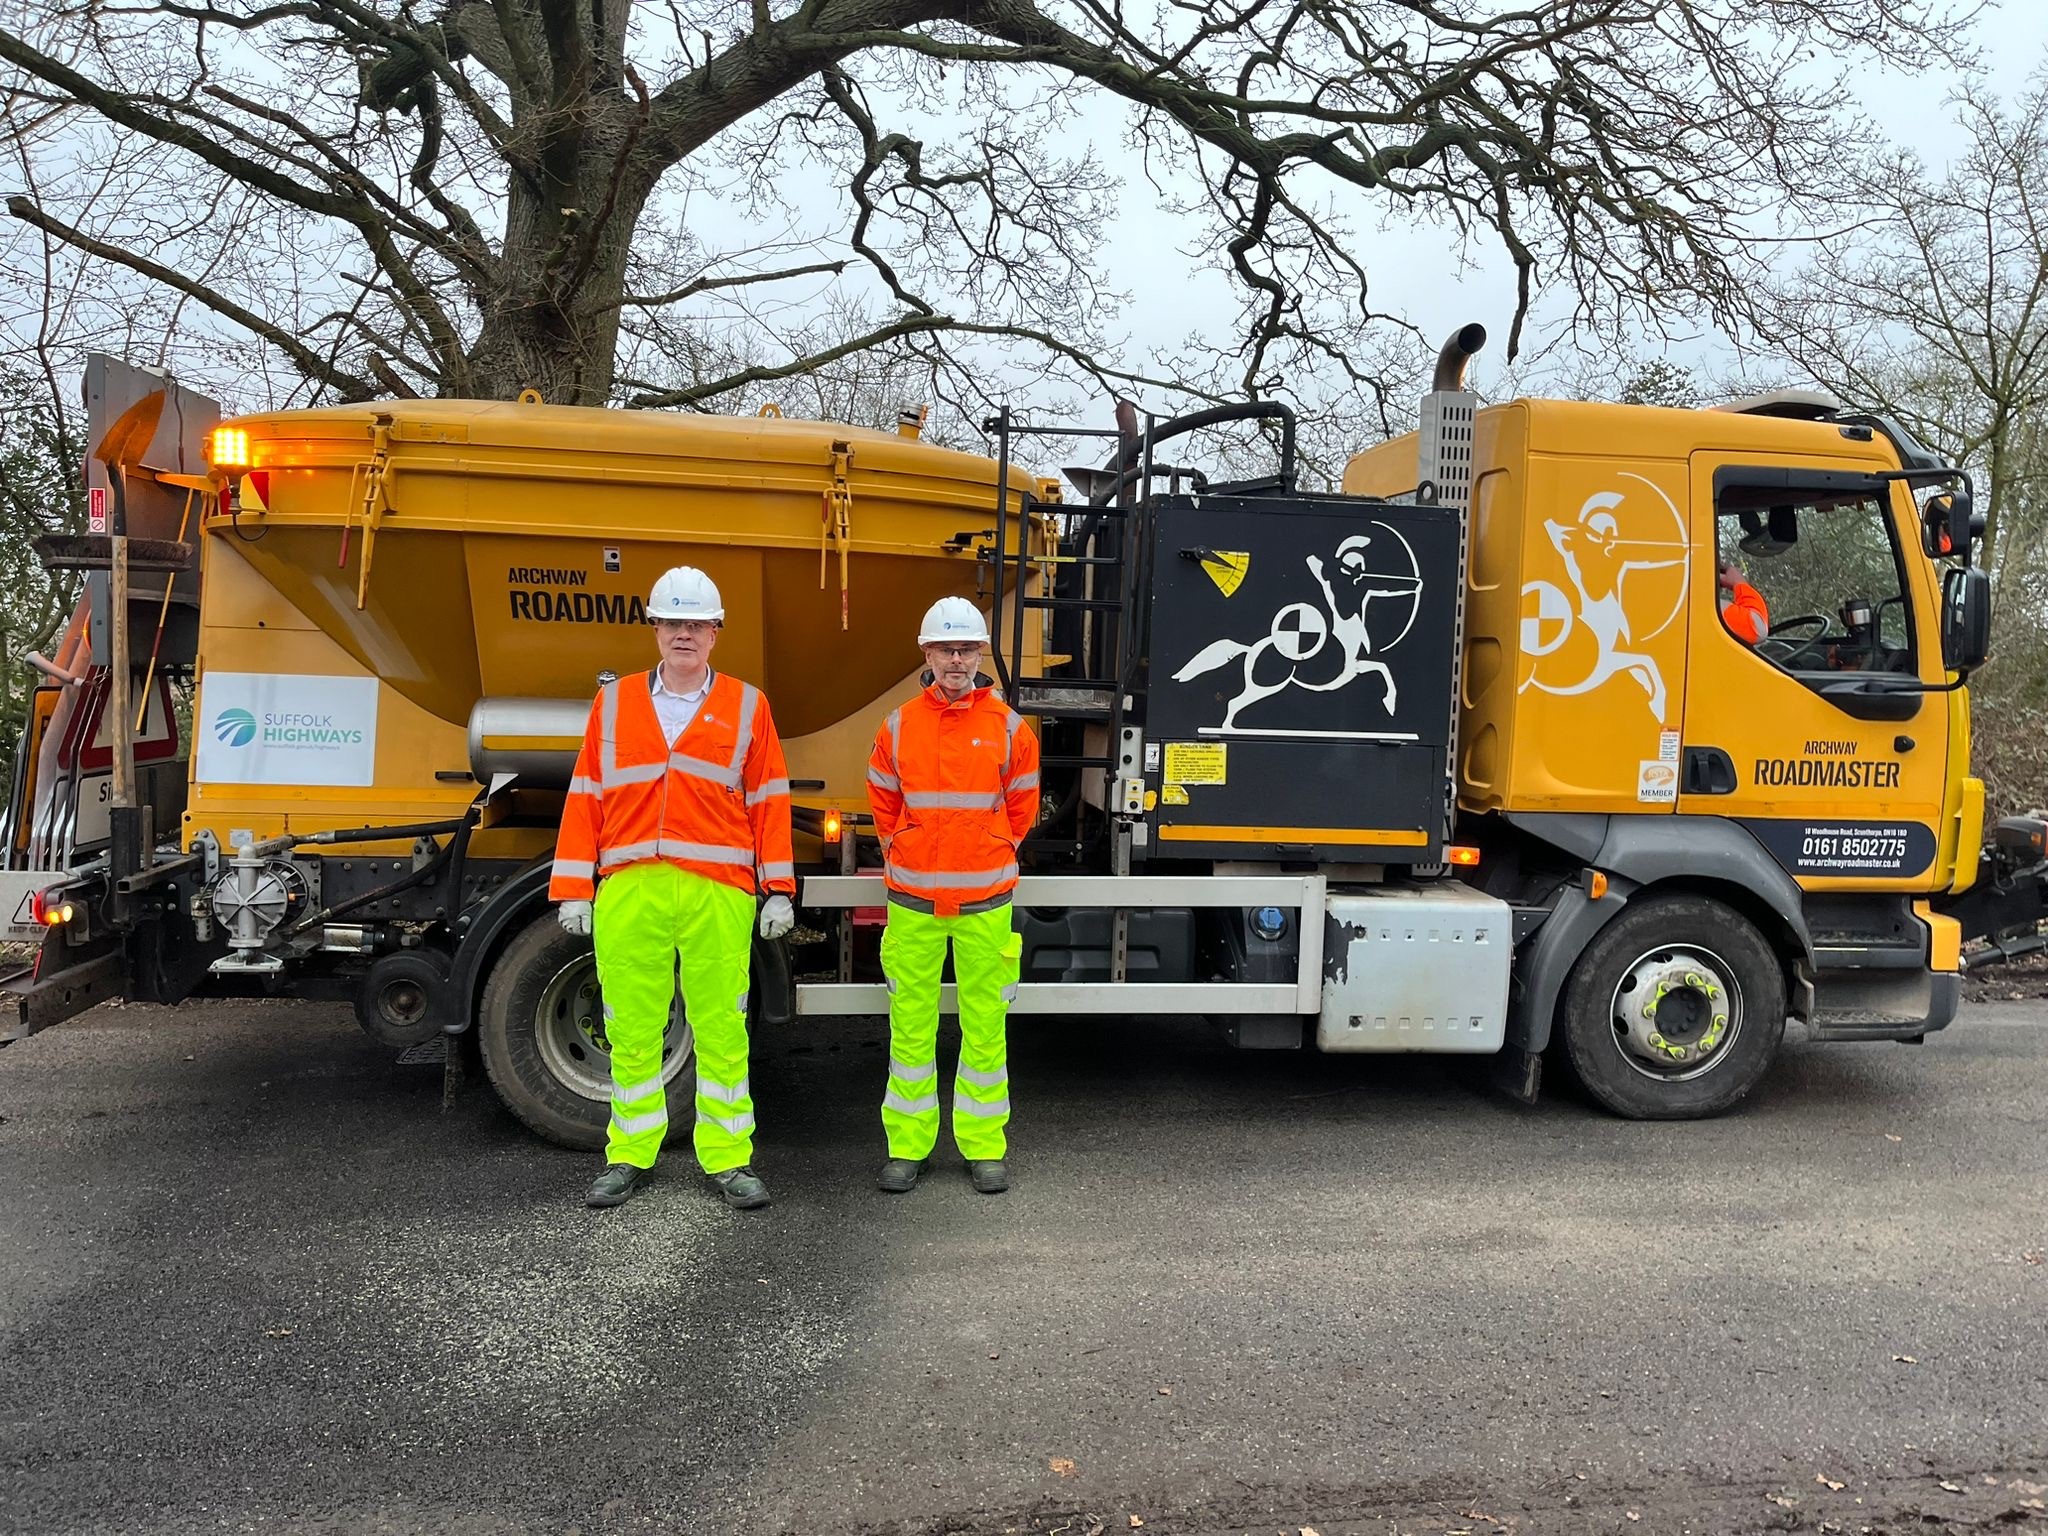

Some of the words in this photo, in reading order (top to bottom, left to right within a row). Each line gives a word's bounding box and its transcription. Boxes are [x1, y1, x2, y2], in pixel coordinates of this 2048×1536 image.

[508, 567, 587, 585] ARCHWAY
[509, 590, 656, 627] ROADMA
[264, 713, 332, 727] SUFFOLK
[263, 728, 362, 743] HIGHWAYS
[1804, 741, 1858, 755] ARCHWAY
[1754, 759, 1900, 788] ROADMASTER
[1640, 789, 1674, 797] MEMBER
[1802, 838, 1838, 856] 0161
[1842, 839, 1906, 857] 8502775
[1798, 858, 1901, 869] www.archwayroadmaster.co.uk
